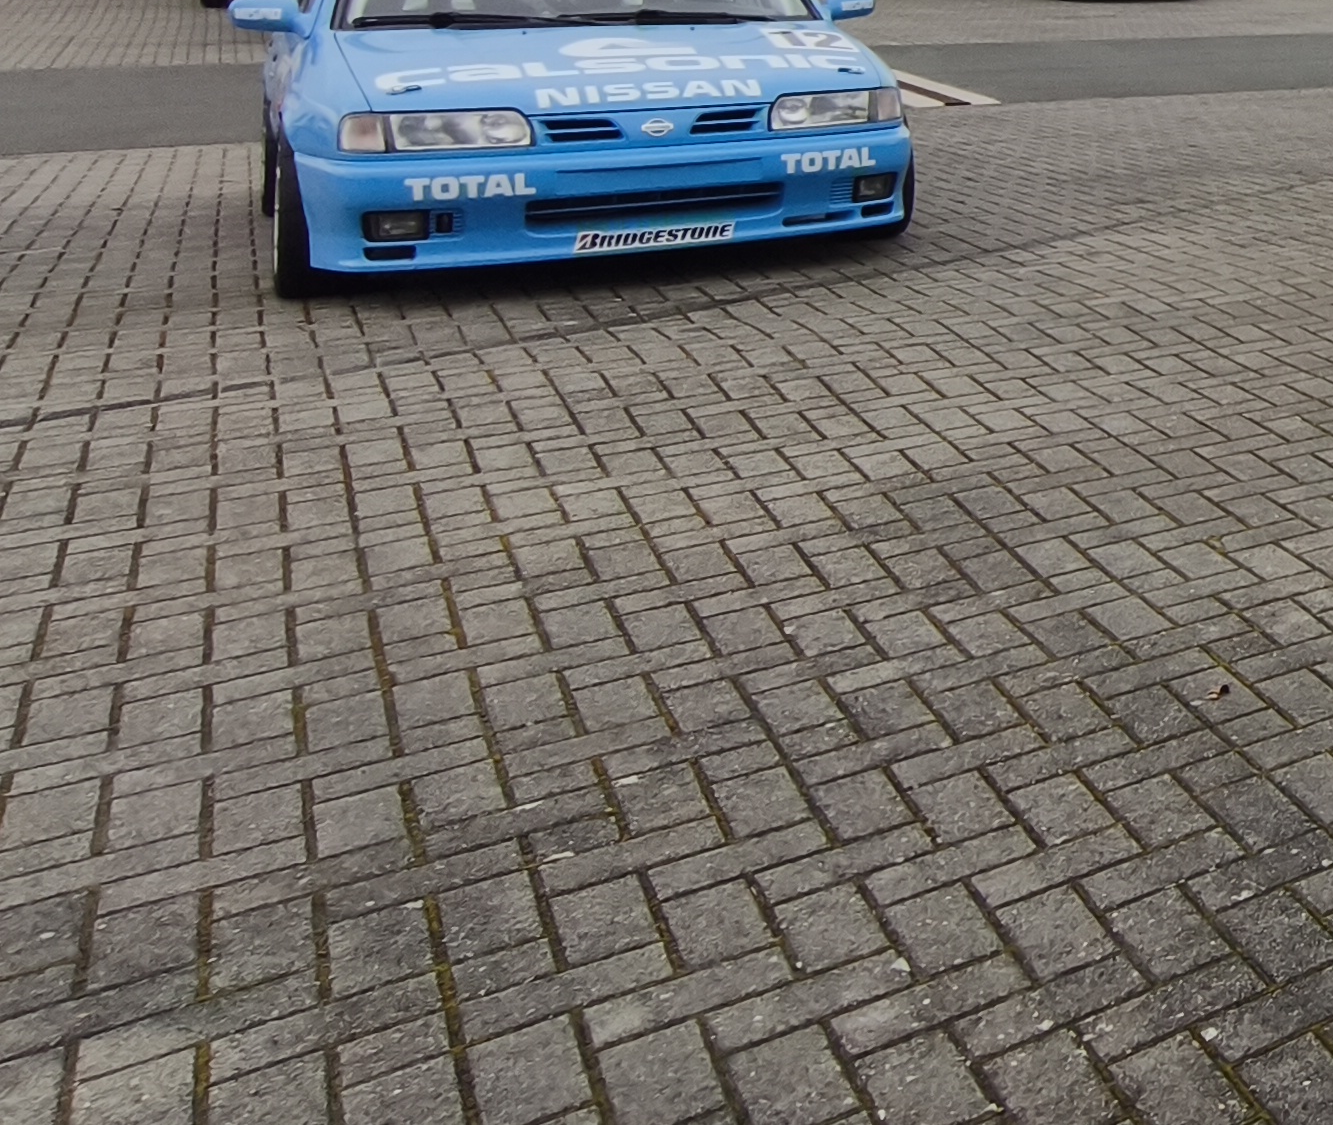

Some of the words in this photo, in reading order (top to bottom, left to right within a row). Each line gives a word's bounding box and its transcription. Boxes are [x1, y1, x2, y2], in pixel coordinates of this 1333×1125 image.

[769, 30, 846, 50] 12
[534, 78, 763, 110] NISSAN
[782, 146, 877, 175] TOTAL
[404, 172, 537, 202] TOTAL
[577, 223, 733, 251] BRIDGESTONE
